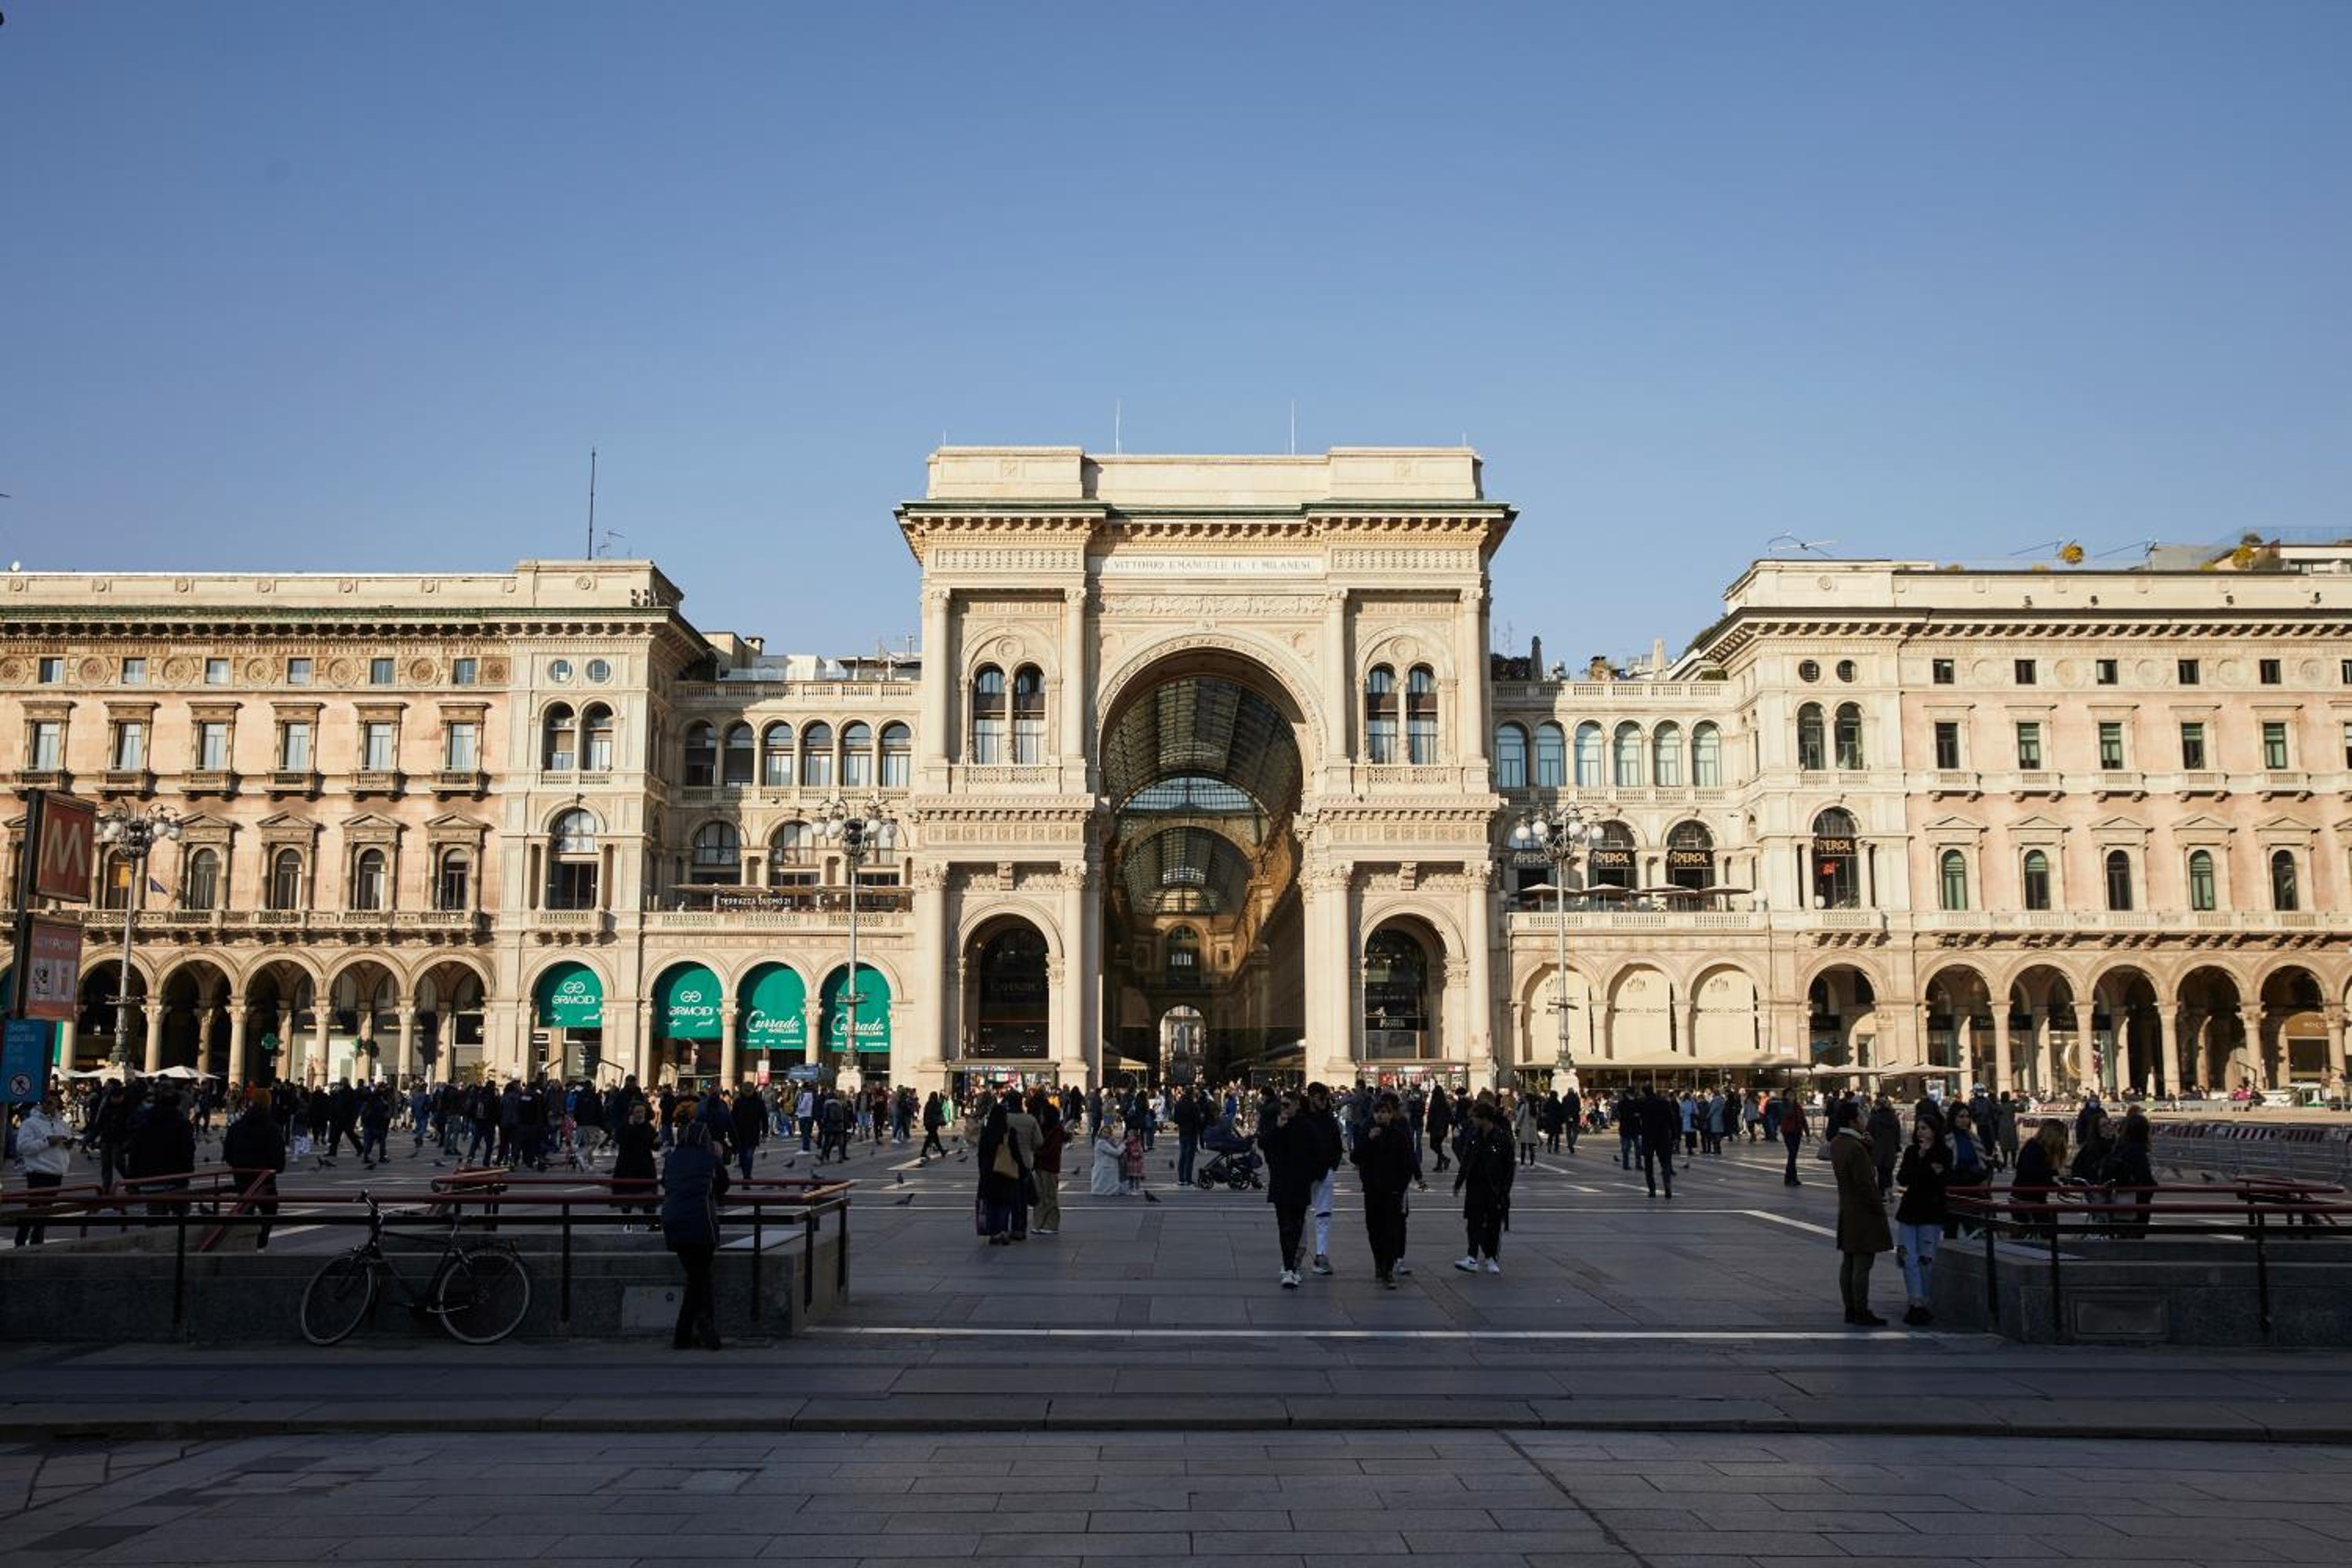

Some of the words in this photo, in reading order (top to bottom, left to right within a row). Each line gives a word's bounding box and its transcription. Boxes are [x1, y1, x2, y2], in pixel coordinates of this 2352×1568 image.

[1169, 561, 1225, 570] EMANUELE
[1261, 561, 1310, 570] MILANESI
[44, 818, 85, 877] M
[1591, 851, 1631, 863] APEROL
[1669, 851, 1708, 863] APEROL
